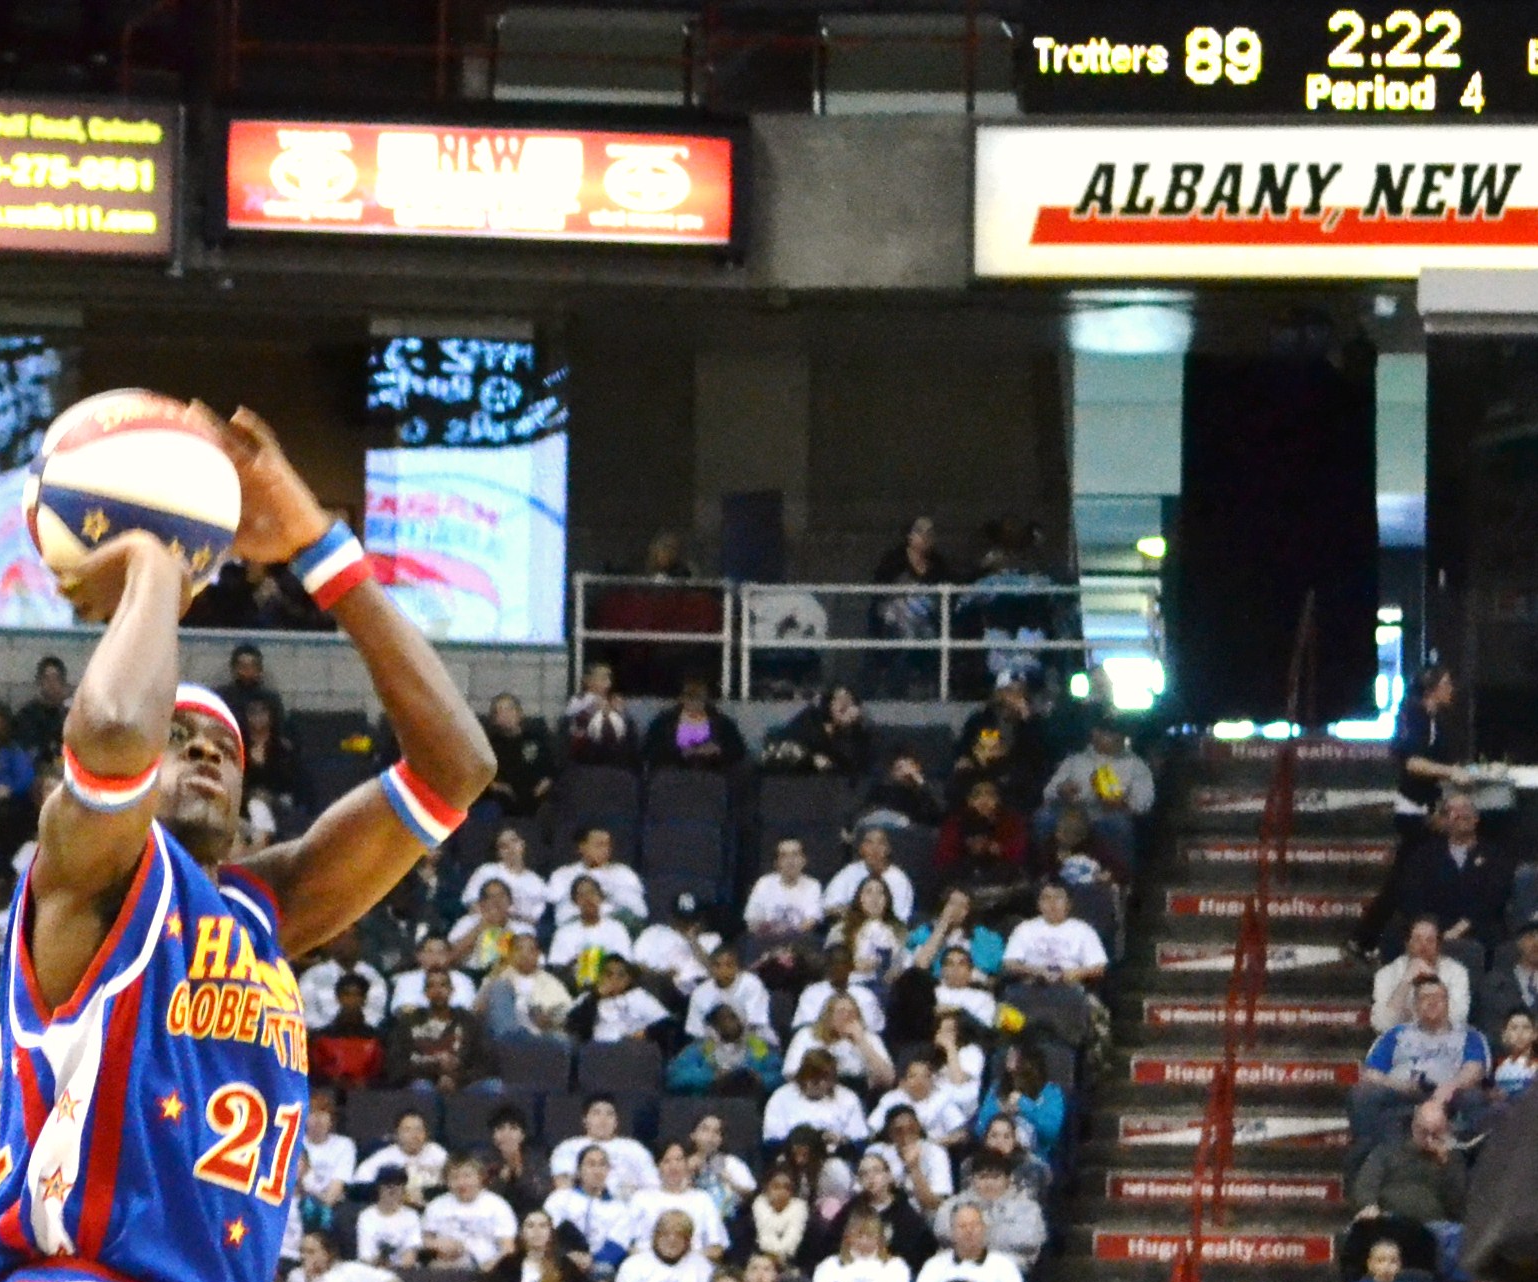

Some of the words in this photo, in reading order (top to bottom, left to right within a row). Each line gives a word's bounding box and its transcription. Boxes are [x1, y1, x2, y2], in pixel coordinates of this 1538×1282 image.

[1032, 36, 1169, 74] Trotters
[1185, 26, 1262, 85] 89
[1328, 9, 1462, 68] 2:22
[1306, 73, 1436, 110] Period
[1460, 70, 1485, 114] 4
[1072, 162, 1344, 232] ALBANY,
[1364, 162, 1523, 221] NEW
[192, 1082, 302, 1207] 21
